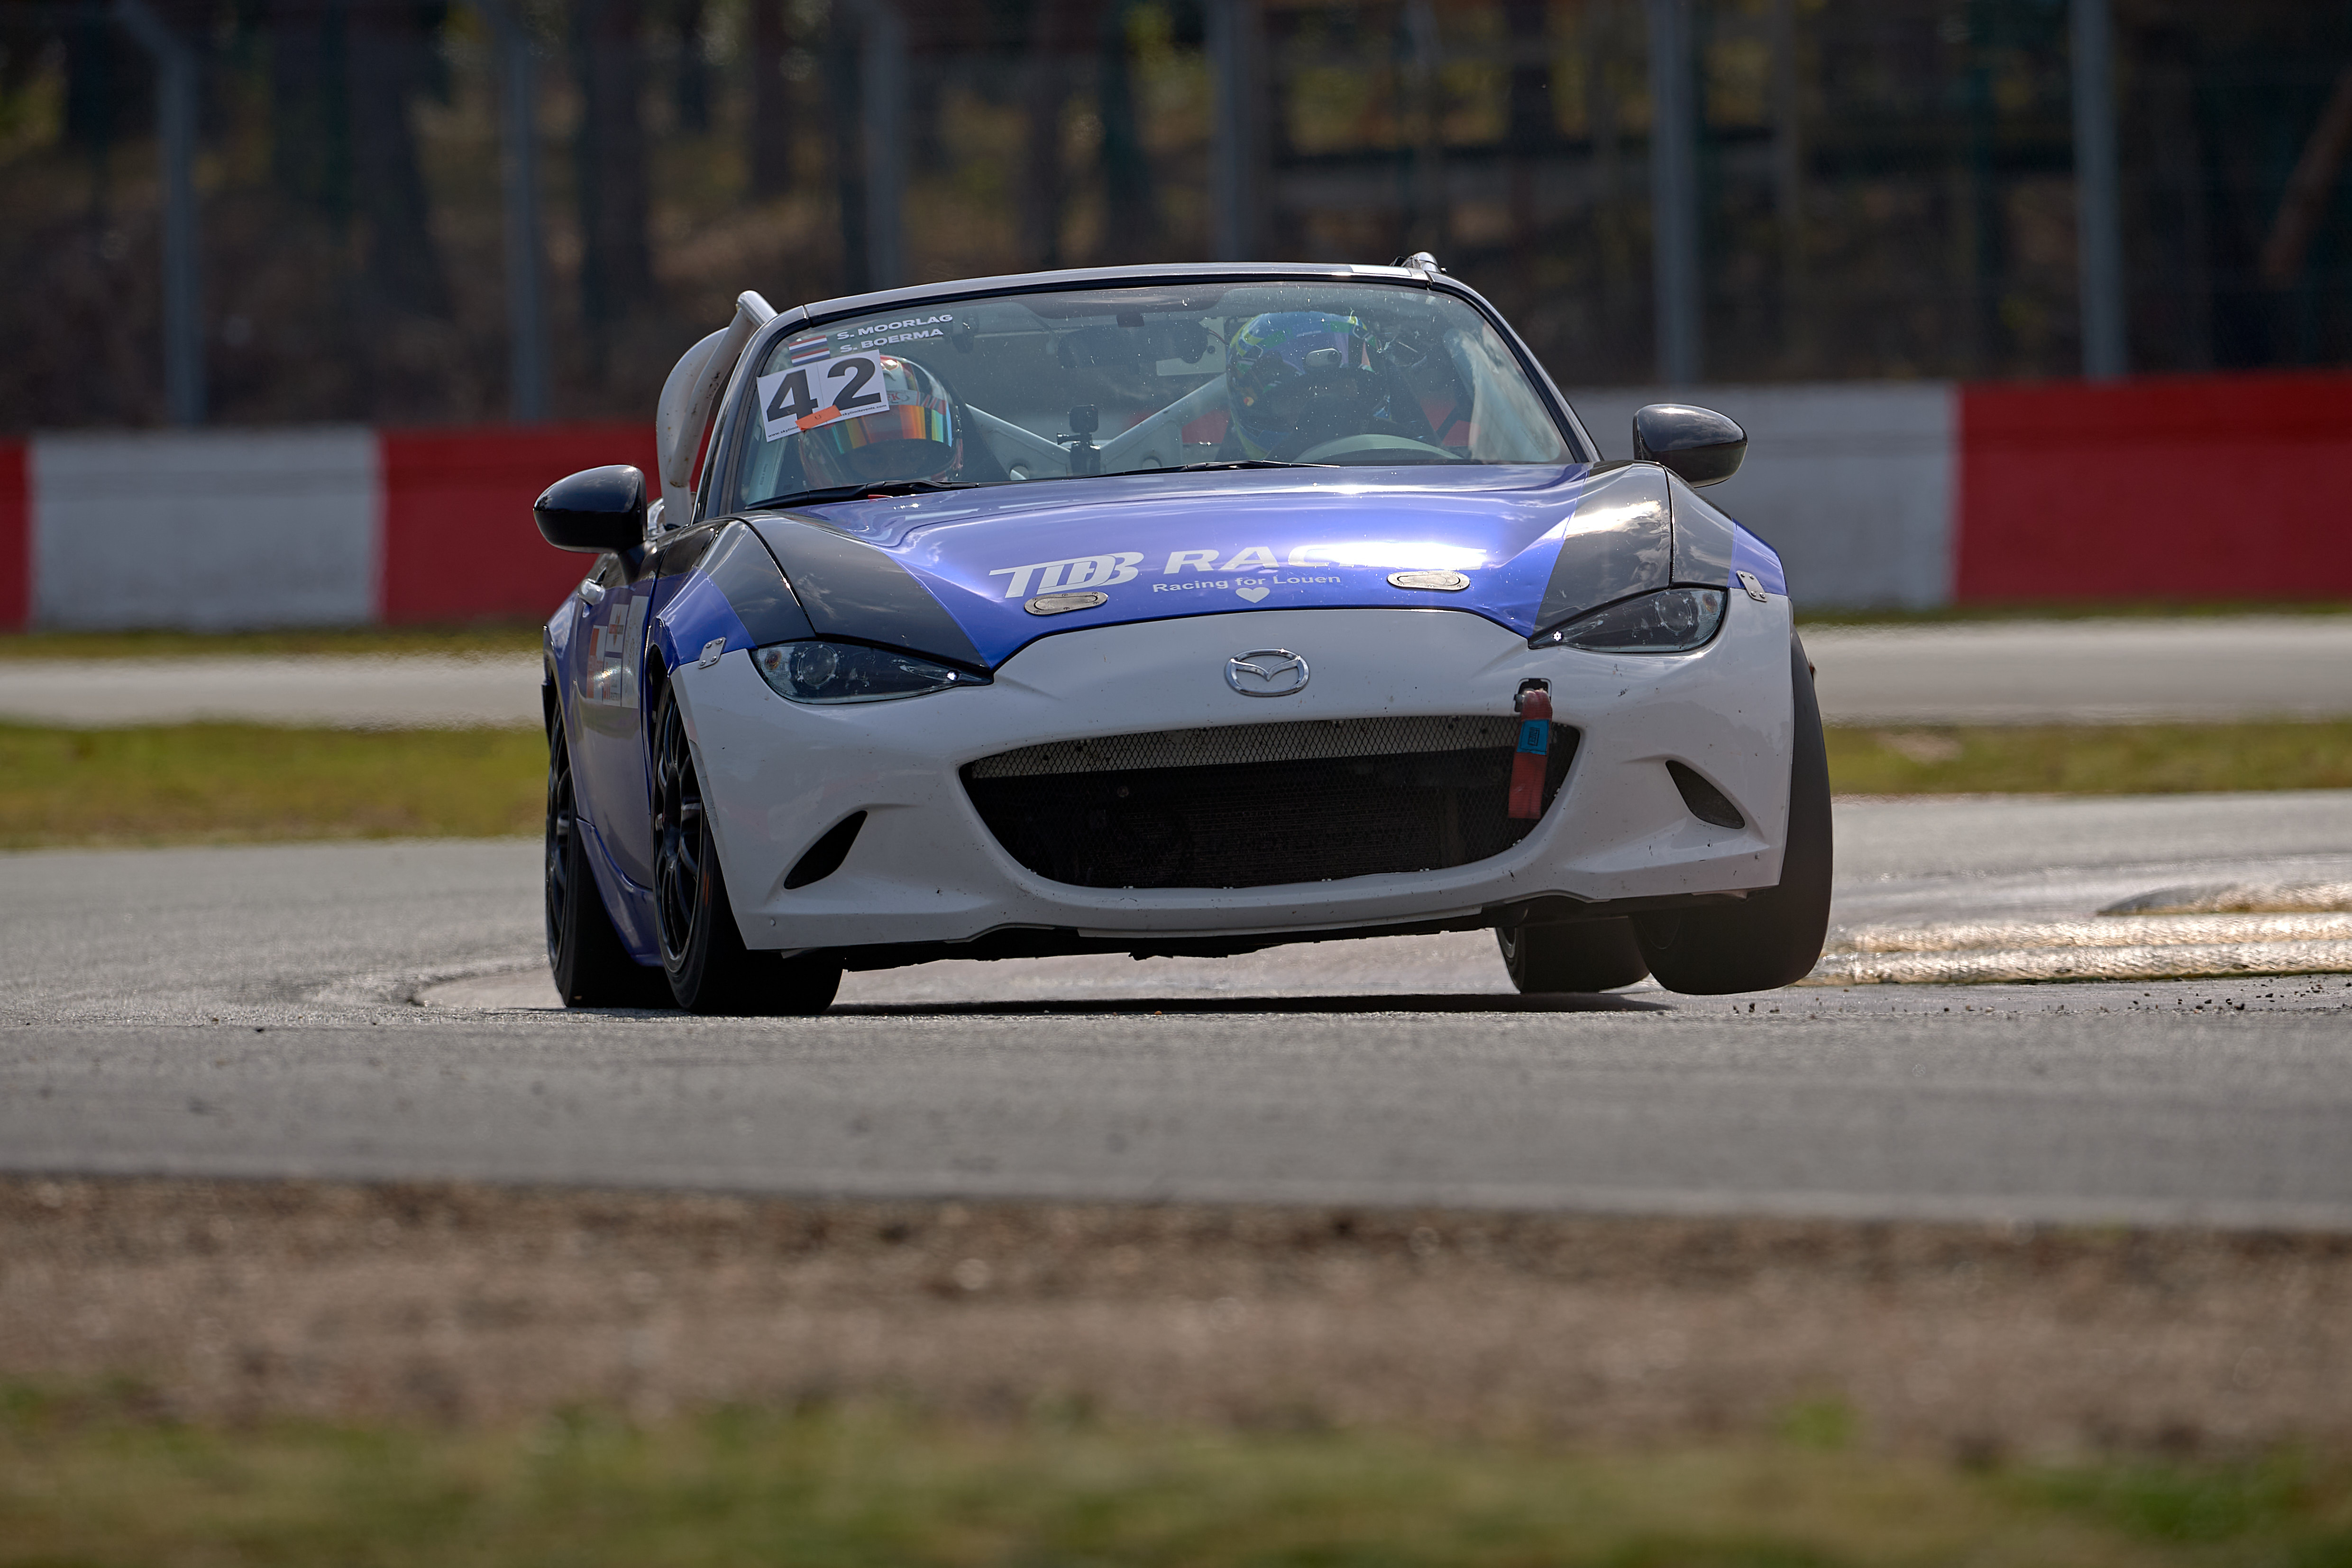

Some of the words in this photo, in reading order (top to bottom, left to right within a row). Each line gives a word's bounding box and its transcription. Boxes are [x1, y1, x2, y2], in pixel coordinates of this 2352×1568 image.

[837, 331, 854, 340] S.
[858, 314, 953, 336] MOORLAG
[840, 344, 858, 353] S.
[861, 329, 943, 349] BOERMA
[767, 358, 881, 422] 42
[842, 404, 887, 416] skylimitevents.com
[768, 426, 798, 437] www.skylimit
[1163, 546, 1487, 574] RAC
[1153, 579, 1229, 592] Racing
[1235, 577, 1265, 586] for
[1273, 576, 1341, 584] Louen
